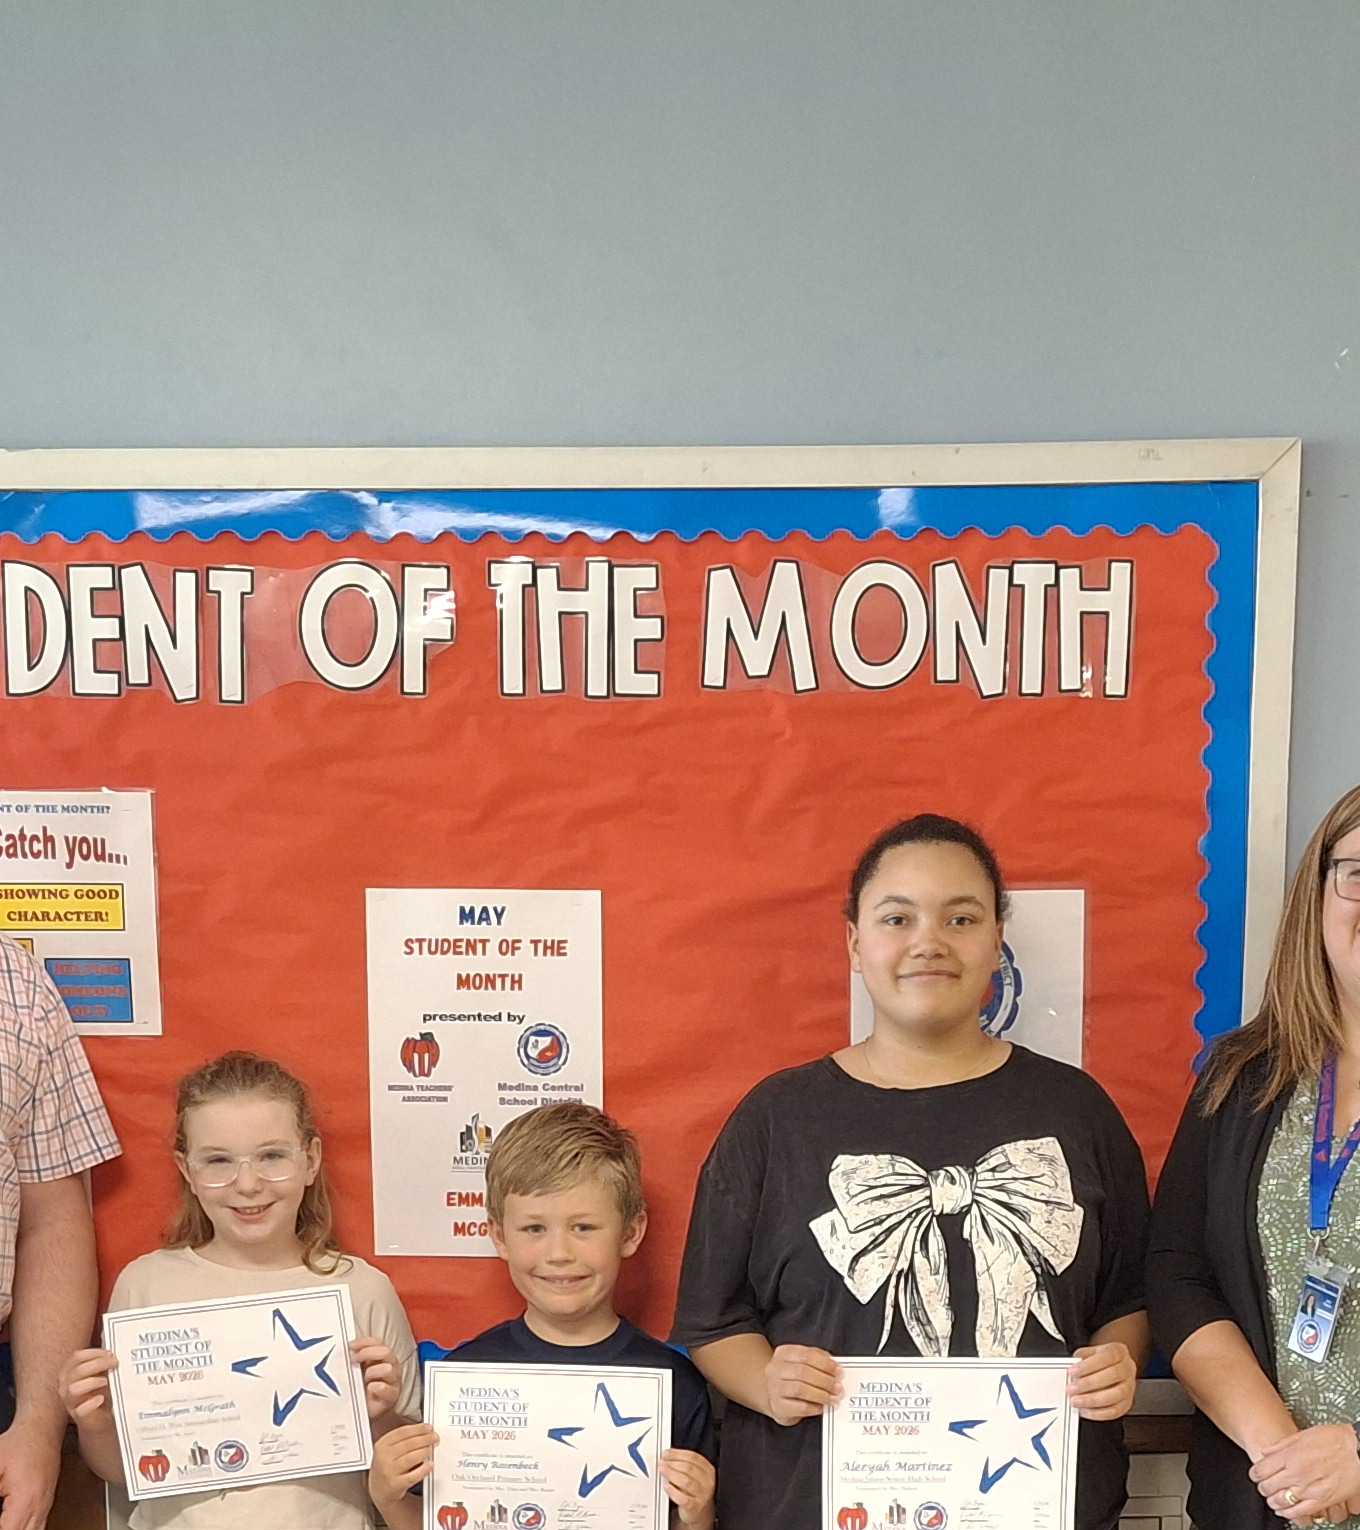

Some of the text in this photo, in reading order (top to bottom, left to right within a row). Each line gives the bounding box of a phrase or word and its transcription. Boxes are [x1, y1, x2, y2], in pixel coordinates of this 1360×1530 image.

[298, 557, 455, 698] OF
[488, 556, 664, 698] THE
[701, 557, 1137, 699] MONTH
[15, 804, 31, 814] OF
[34, 804, 58, 814] THE
[61, 805, 111, 814] MONTH?
[64, 835, 128, 869] you...
[74, 888, 120, 900] GOOD
[6, 910, 109, 922] CHARACTER!
[459, 905, 507, 926] MAY
[403, 938, 568, 957] STUDENT OF THE
[456, 973, 523, 991] MONTH
[422, 1012, 526, 1025] presented by
[497, 1082, 584, 1093] Medina Central
[499, 1097, 537, 1106] School
[138, 1328, 200, 1344] MEDINA'S
[131, 1341, 213, 1361] STUDENT OF
[135, 1355, 213, 1375] THE MONTH
[147, 1373, 176, 1386] MAY
[459, 1387, 520, 1398] MEDINA'S
[859, 1382, 922, 1393] MEDINA'S
[449, 1401, 529, 1413] STUDENT OF
[849, 1397, 932, 1408] STUDENT OF
[450, 1415, 528, 1427] THE MONTH
[850, 1411, 930, 1421] THE MONTH
[460, 1430, 488, 1440] MAY
[862, 1425, 920, 1435] MAY 2026
[894, 1462, 953, 1472] Martinez
